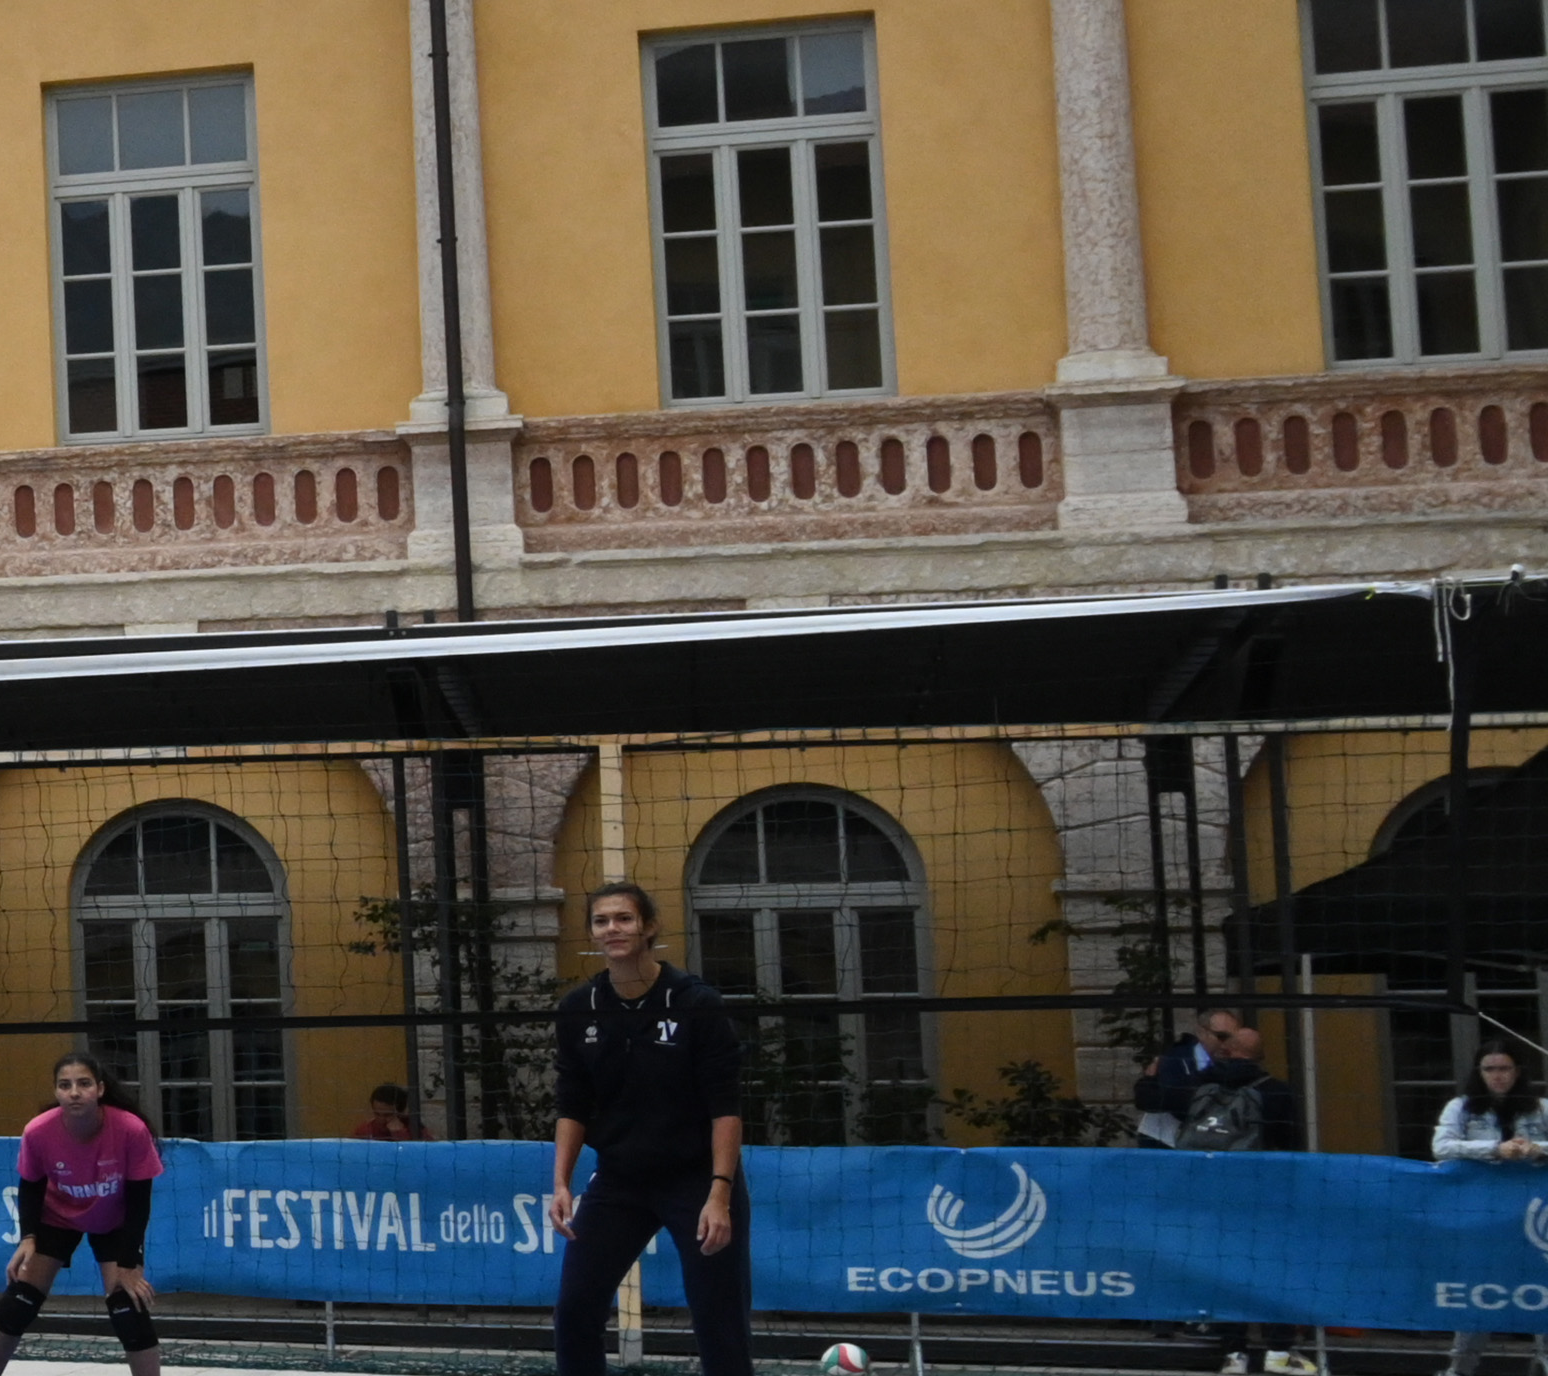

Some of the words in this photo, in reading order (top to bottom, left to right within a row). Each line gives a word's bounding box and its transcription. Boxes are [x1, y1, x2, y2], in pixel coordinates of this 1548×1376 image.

[203, 1200, 217, 1238] il
[223, 1189, 436, 1252] FESTIVAL
[439, 1203, 506, 1244] dello
[846, 1266, 1136, 1297] ECOPNEUS
